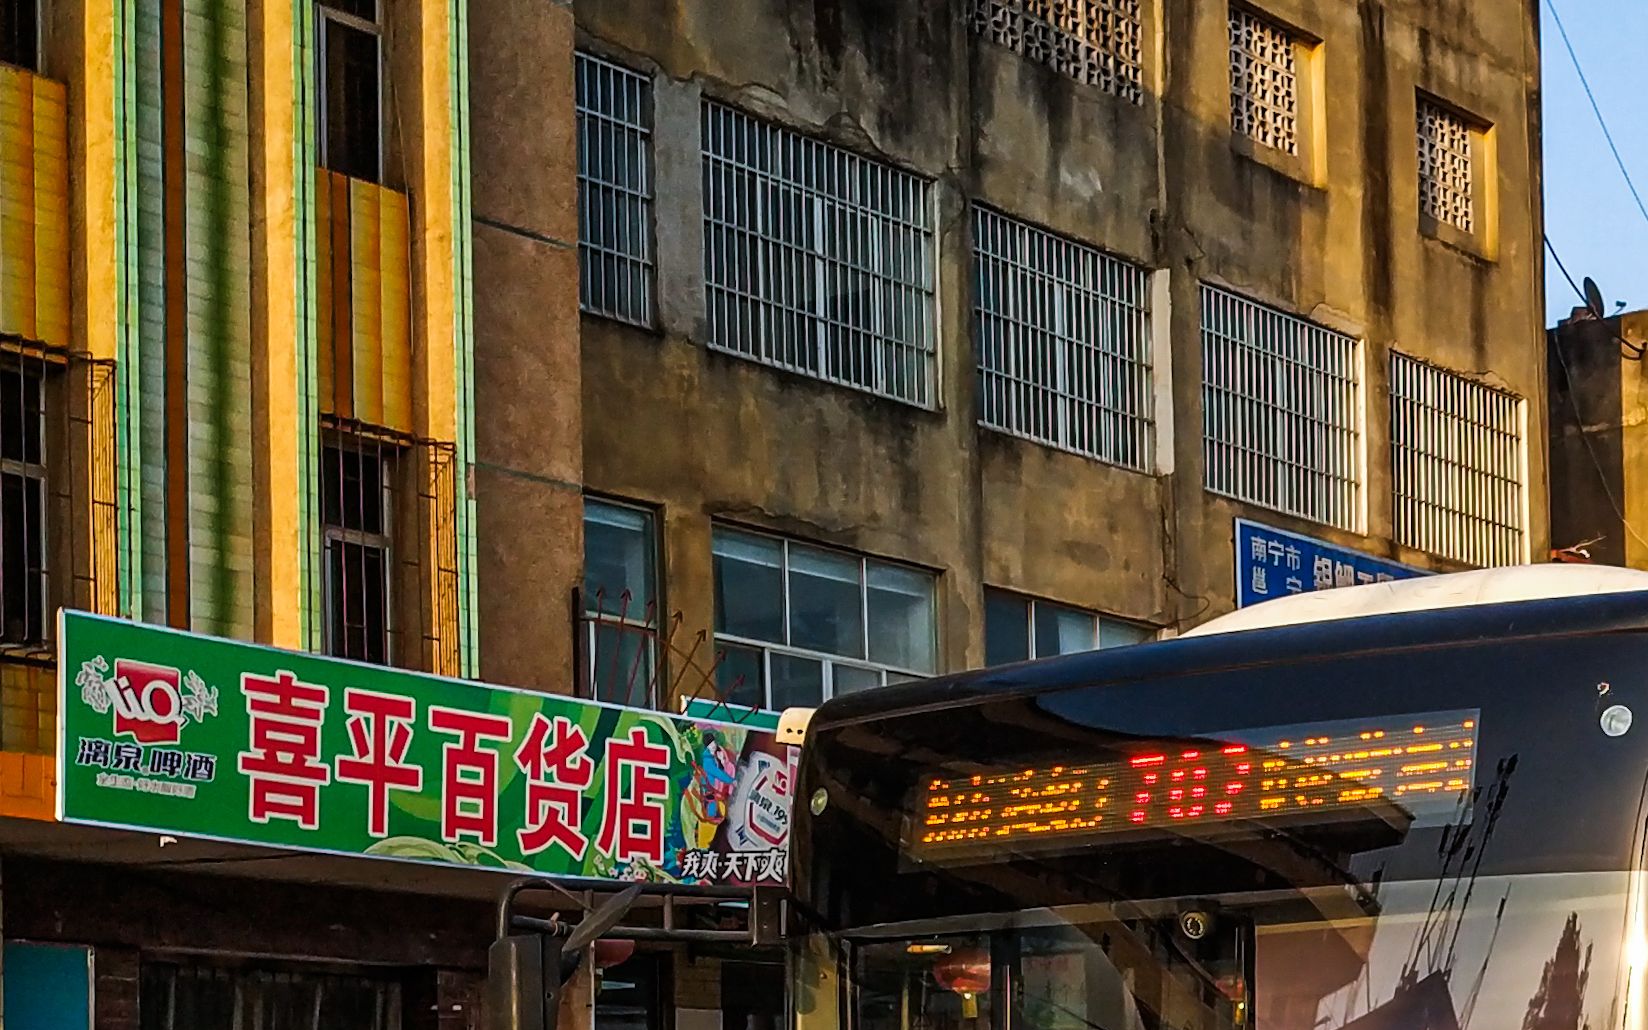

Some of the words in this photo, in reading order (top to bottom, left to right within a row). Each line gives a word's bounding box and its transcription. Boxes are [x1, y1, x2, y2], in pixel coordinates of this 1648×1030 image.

[1250, 536, 1302, 572] 南宁市
[75, 737, 217, 782] 漓泉啤酒
[238, 670, 672, 865] 喜平百货店
